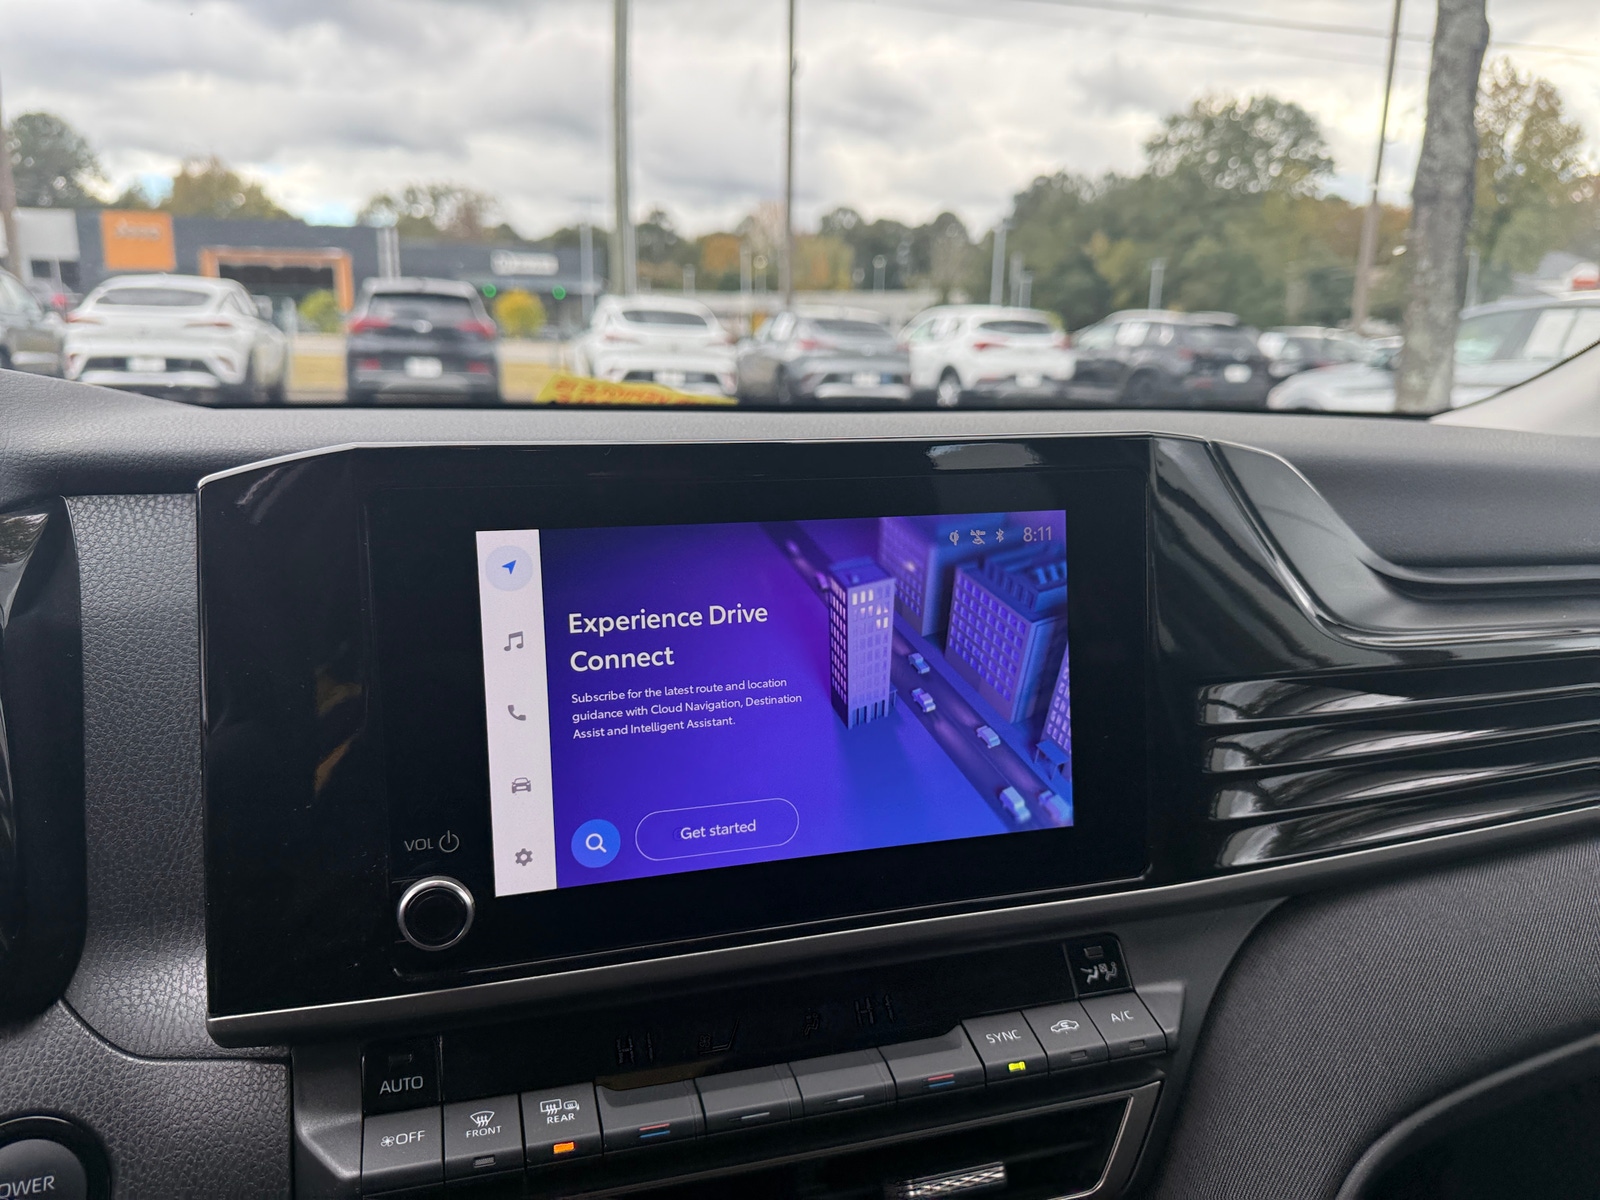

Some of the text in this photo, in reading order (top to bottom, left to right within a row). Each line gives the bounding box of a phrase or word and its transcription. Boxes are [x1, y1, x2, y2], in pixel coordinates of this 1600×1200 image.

[1023, 526, 1052, 542] 8:11
[568, 603, 768, 637] Experience Drive
[570, 646, 675, 672] Connect
[571, 678, 788, 704] Subscribe for the latest route and location
[572, 694, 803, 724] guidance with Cloud Navigation, Destination
[573, 716, 736, 740] Assist and Intelligent Assistant.
[680, 818, 757, 840] Get started
[403, 837, 434, 852] VOL
[1110, 1010, 1135, 1023] A/C
[984, 1029, 1022, 1044] SYNC
[379, 1075, 424, 1095] AUTO
[546, 1112, 576, 1125] REAR
[395, 1130, 426, 1145] OFF
[465, 1125, 502, 1138] FRONT
[0, 1175, 56, 1199] OWER
